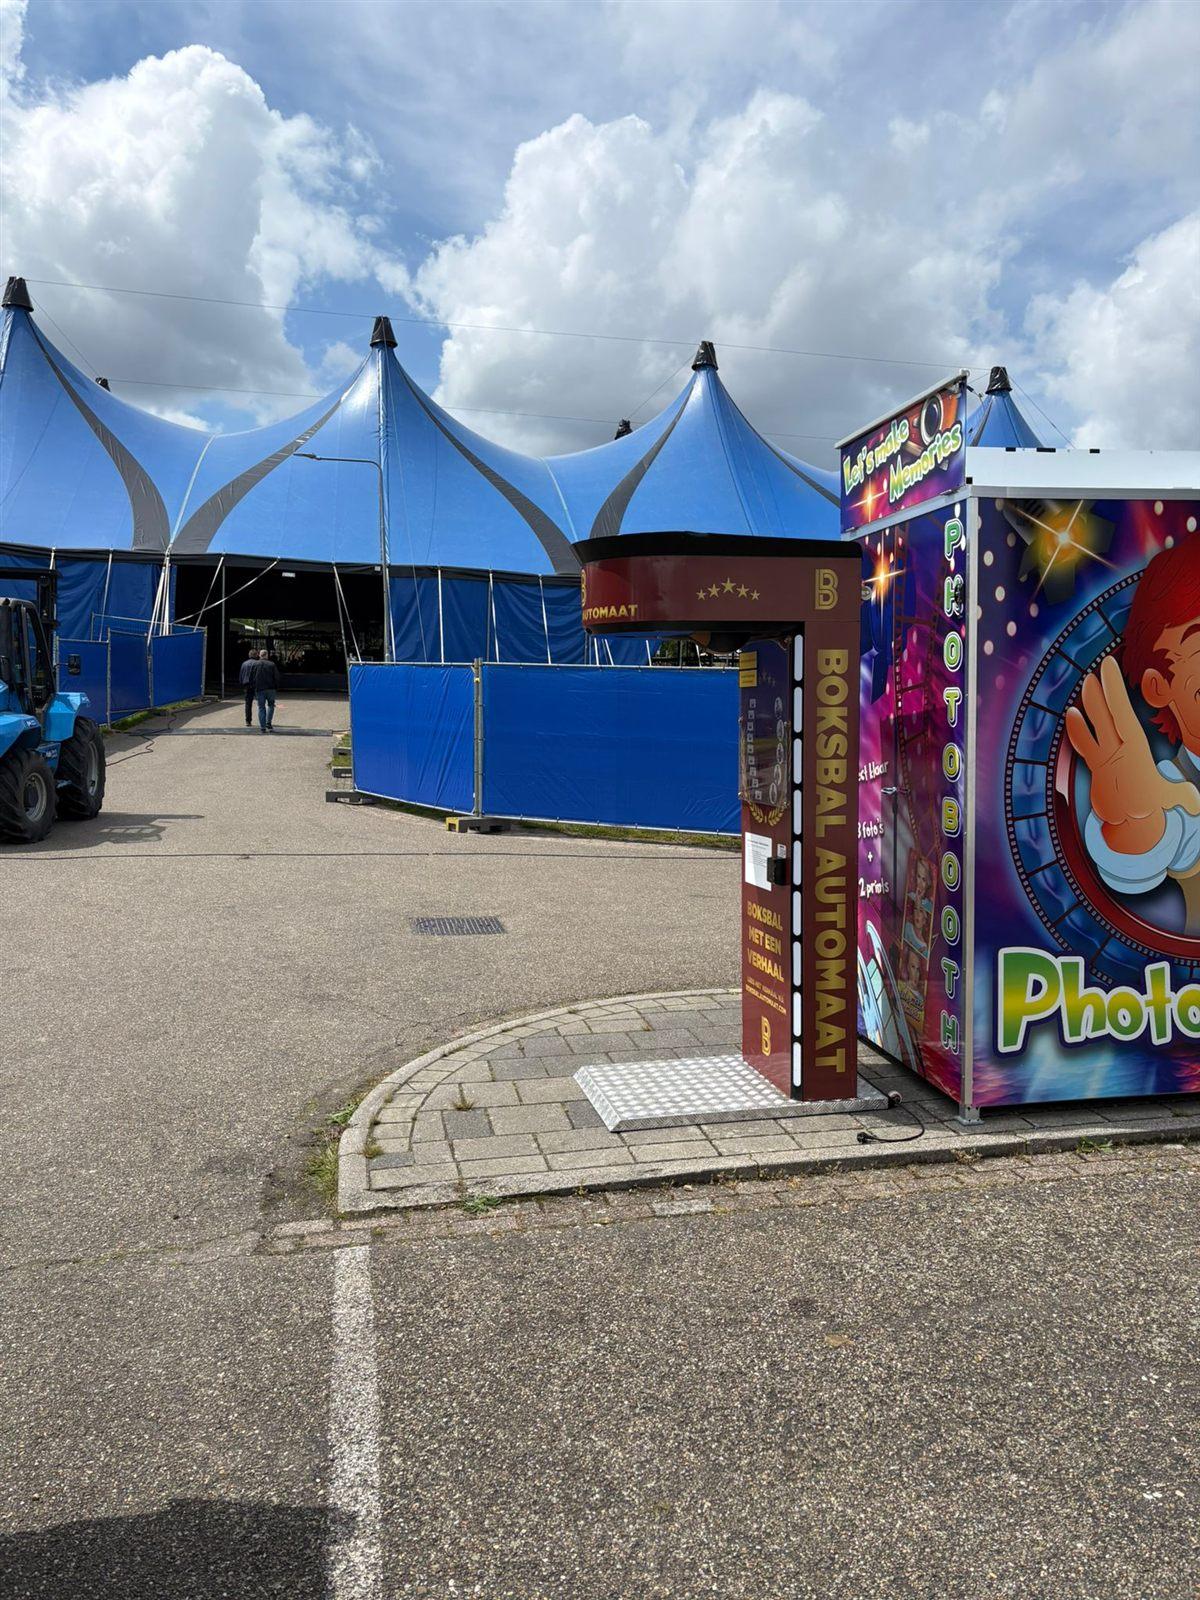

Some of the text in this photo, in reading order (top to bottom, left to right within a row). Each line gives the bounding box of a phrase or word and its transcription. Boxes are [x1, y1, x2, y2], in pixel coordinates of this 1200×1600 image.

[843, 419, 909, 495] Let's make
[889, 423, 962, 503] Memories
[862, 818, 885, 838] foto's
[814, 649, 848, 1073] BOKSBAL AUTOMAAT
[858, 876, 890, 898] 2 prints
[747, 900, 783, 931] BOKSBAL
[748, 925, 782, 955] MET EEN
[747, 947, 784, 982] VERHAAL
